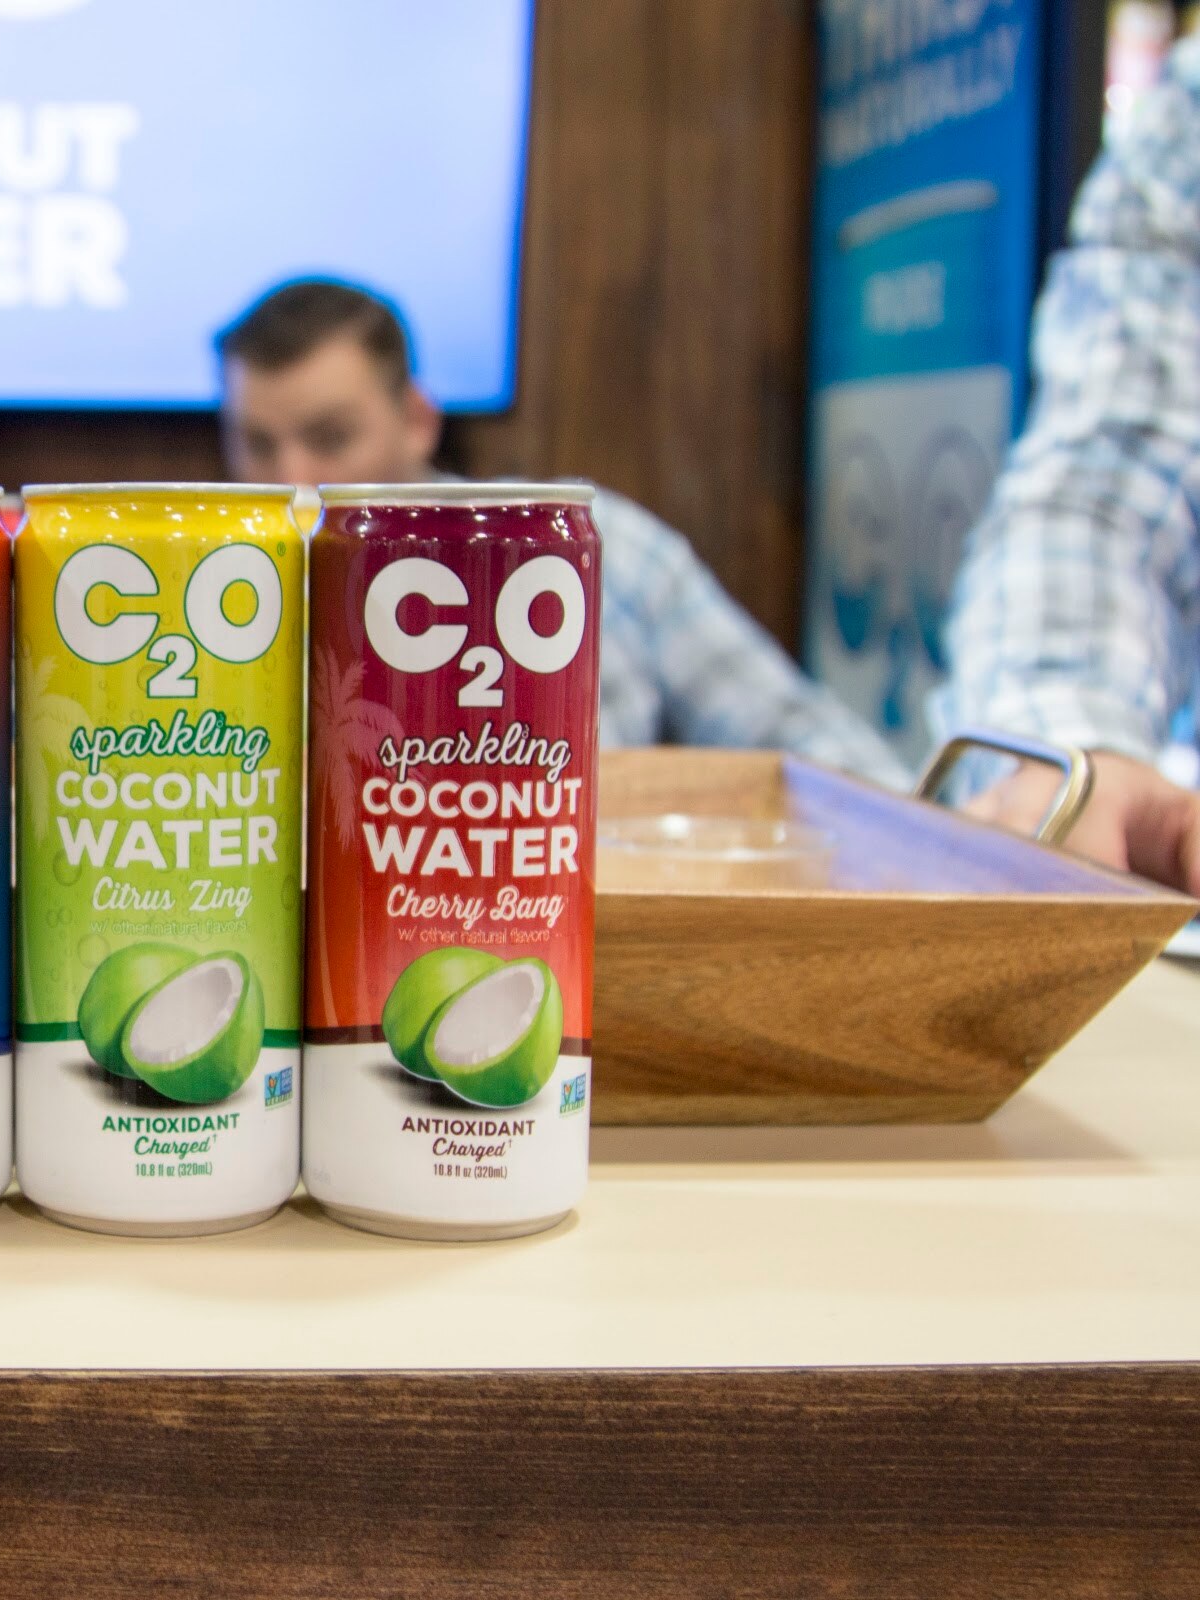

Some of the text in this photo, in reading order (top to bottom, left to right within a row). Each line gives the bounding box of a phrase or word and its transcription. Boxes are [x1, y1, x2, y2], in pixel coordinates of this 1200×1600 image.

[70, 708, 270, 776] sparkling
[378, 721, 572, 785] sparkling
[55, 768, 281, 811] COCONUT
[362, 778, 582, 819] COCONUT
[56, 814, 279, 869] WATER
[362, 822, 579, 877] WATER
[92, 876, 252, 918] Citrus Zing
[387, 884, 566, 931] Cherry Bang
[102, 1113, 240, 1133] ANTIOXIDANT
[401, 1117, 535, 1136] ANTIOXIDANT
[135, 1163, 156, 1177] 10.8
[433, 1163, 453, 1177] 10.8
